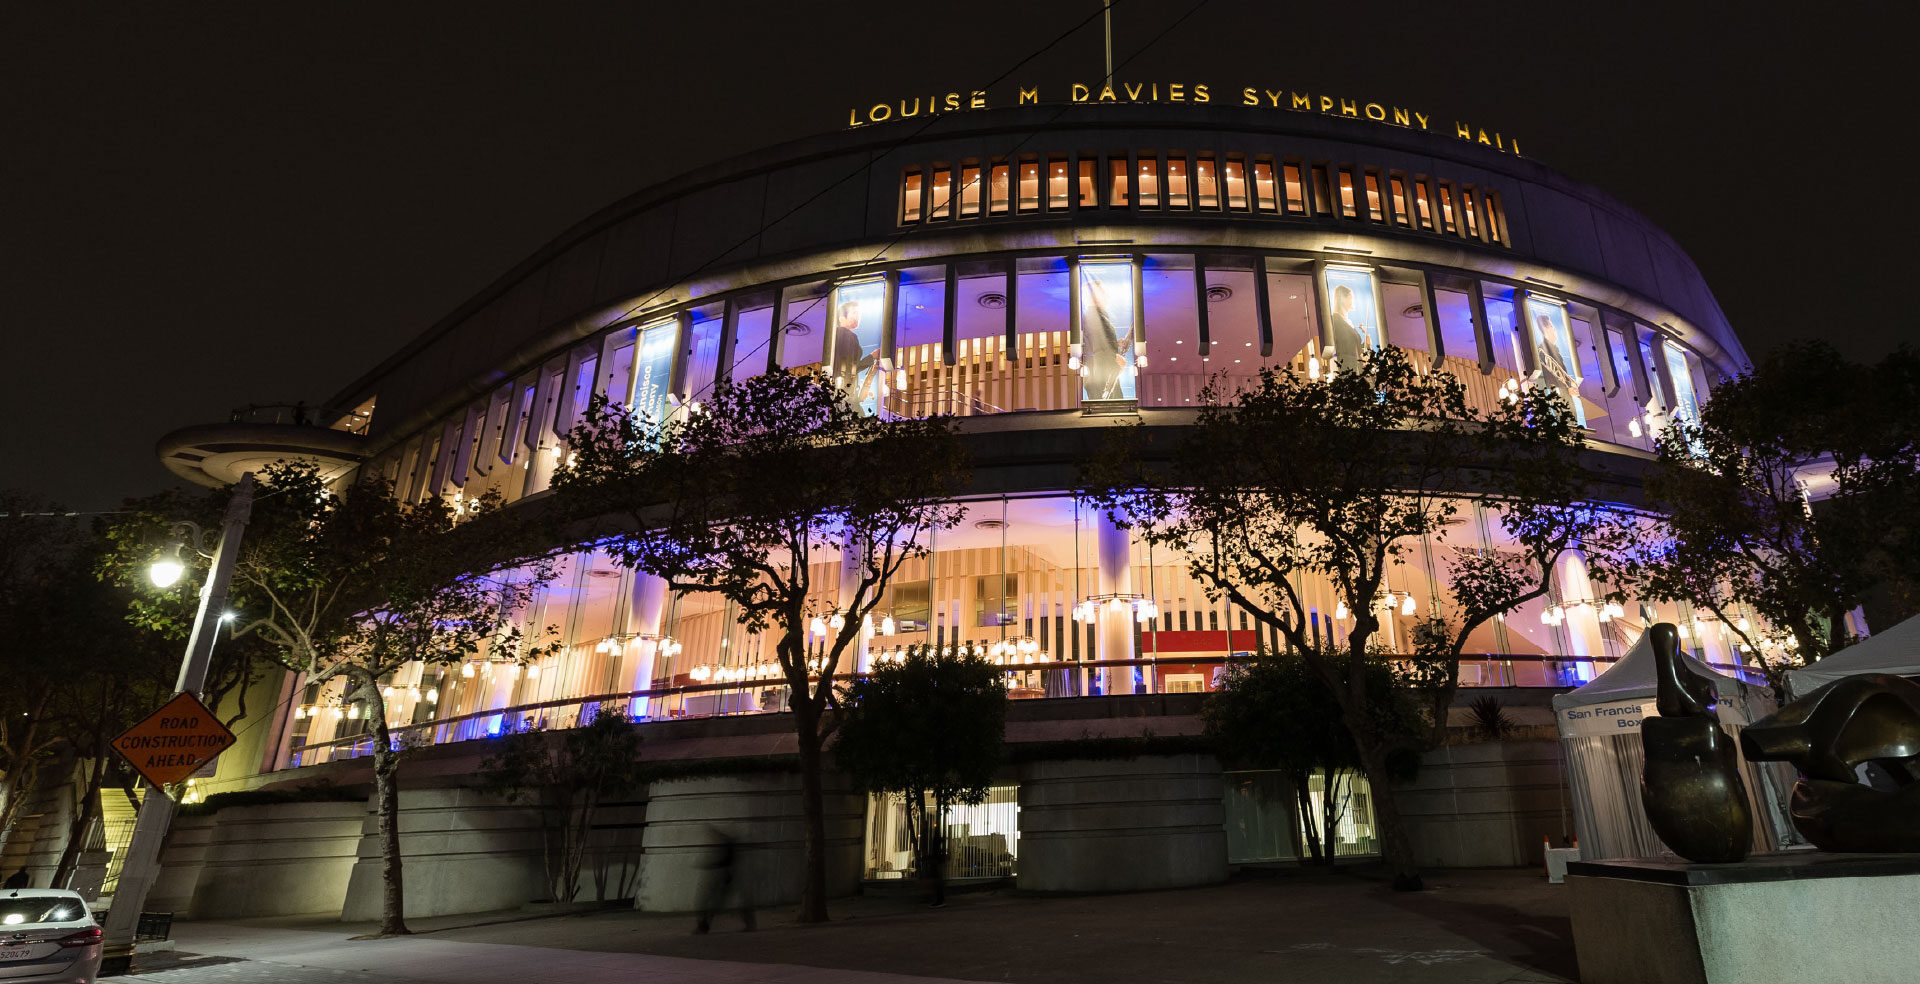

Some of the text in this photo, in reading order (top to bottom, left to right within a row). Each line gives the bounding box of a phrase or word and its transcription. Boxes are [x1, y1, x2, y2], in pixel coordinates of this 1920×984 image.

[849, 90, 986, 126] LOUISE
[1019, 86, 1039, 105] M
[1072, 82, 1211, 103] DAVIES
[1243, 87, 1430, 130] SYMPHONY
[1568, 709, 1591, 720] San
[160, 717, 199, 729] ROAD
[1617, 719, 1642, 728] Box
[121, 734, 227, 749] CONSTRUCTION
[145, 754, 196, 768] AHEAD
